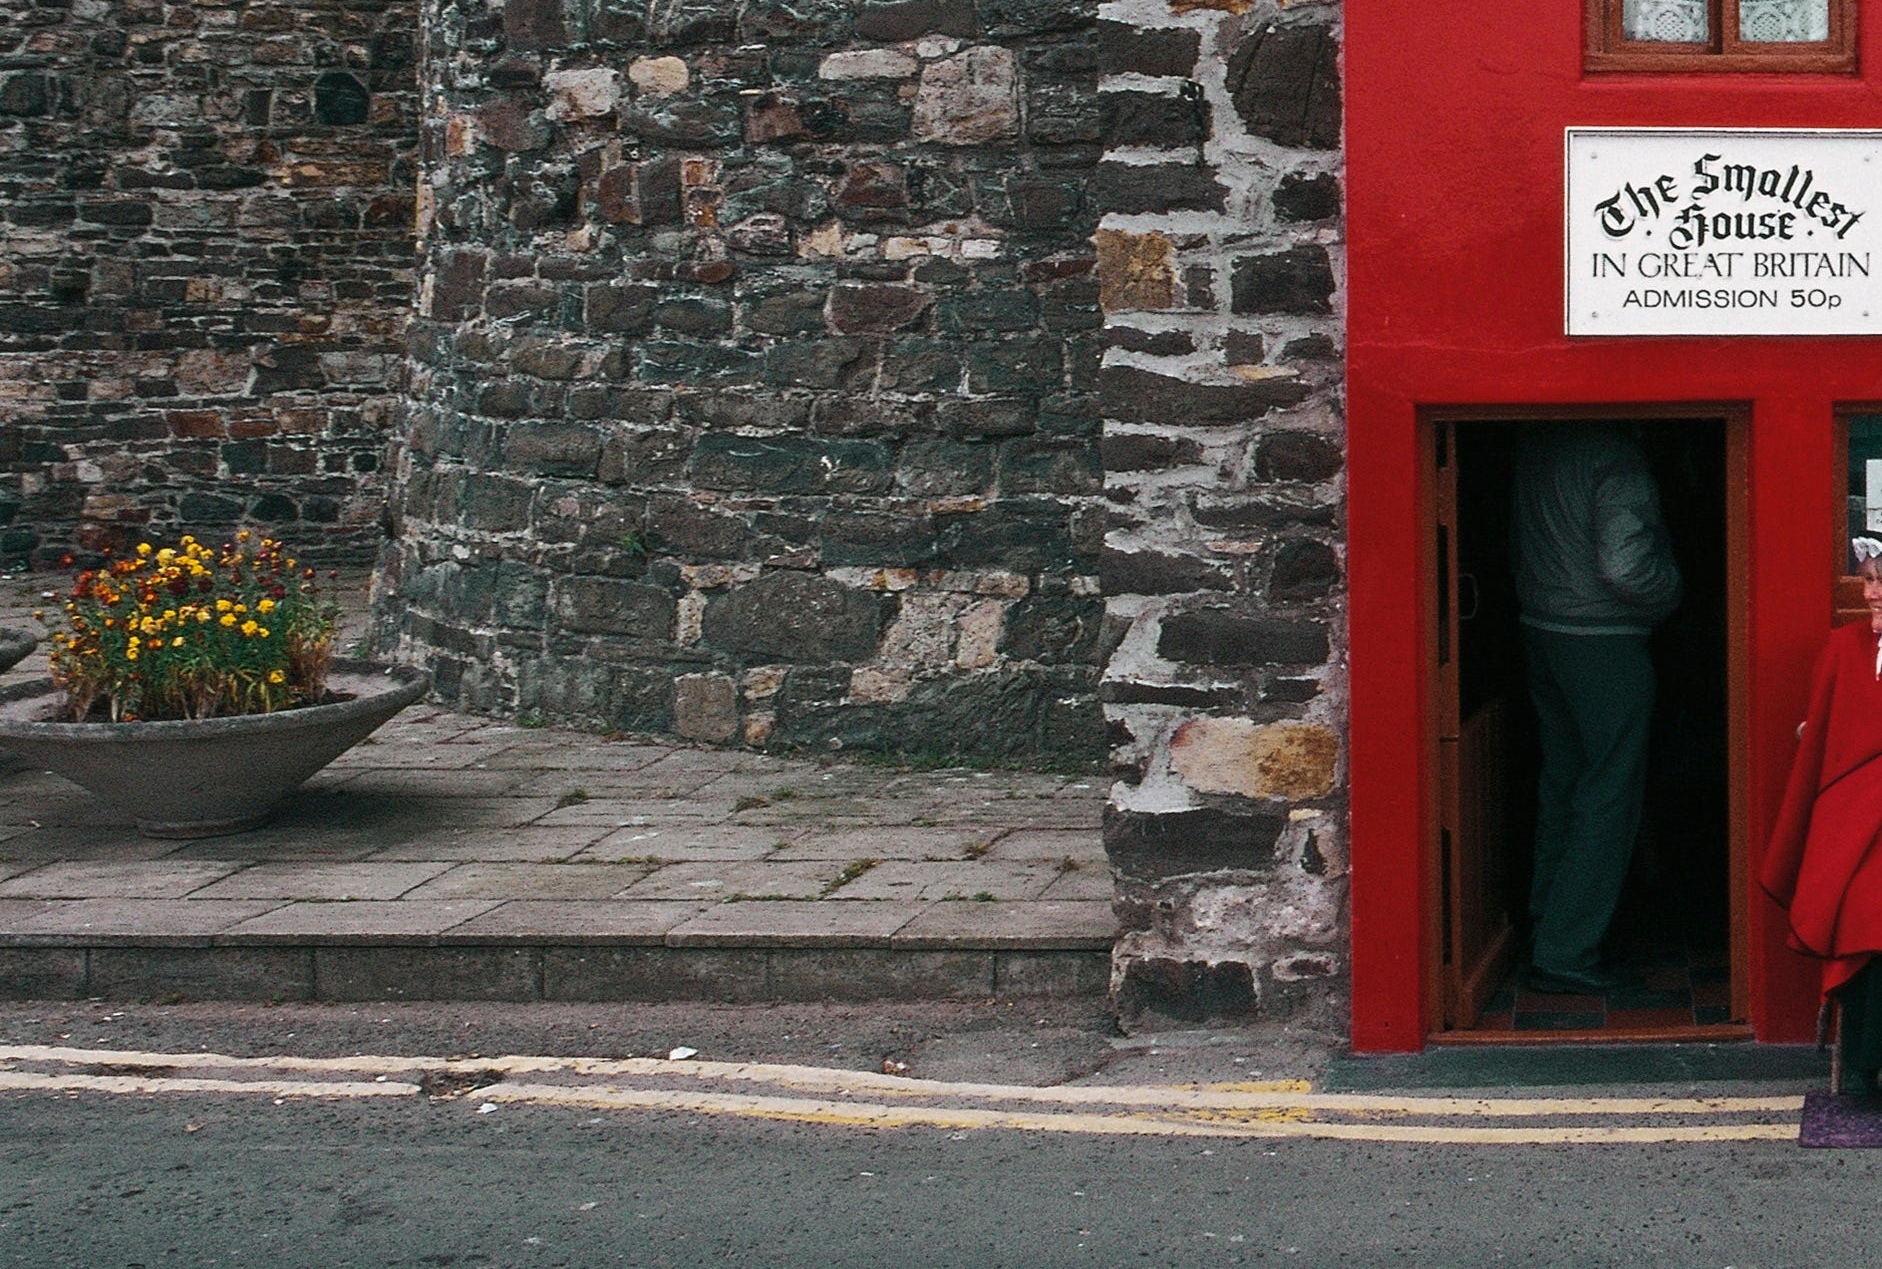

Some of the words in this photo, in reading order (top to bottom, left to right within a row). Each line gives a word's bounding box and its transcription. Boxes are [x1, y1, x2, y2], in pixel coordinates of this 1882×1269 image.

[1594, 174, 1679, 237] The
[1689, 153, 1867, 240] Smallest
[1669, 204, 1796, 251] House
[1592, 252, 1626, 278] IN
[1638, 252, 1743, 279] GREAT
[1754, 252, 1871, 278] BRITAIN
[1622, 289, 1778, 309] ADMISSION
[1790, 288, 1842, 310] 50p
